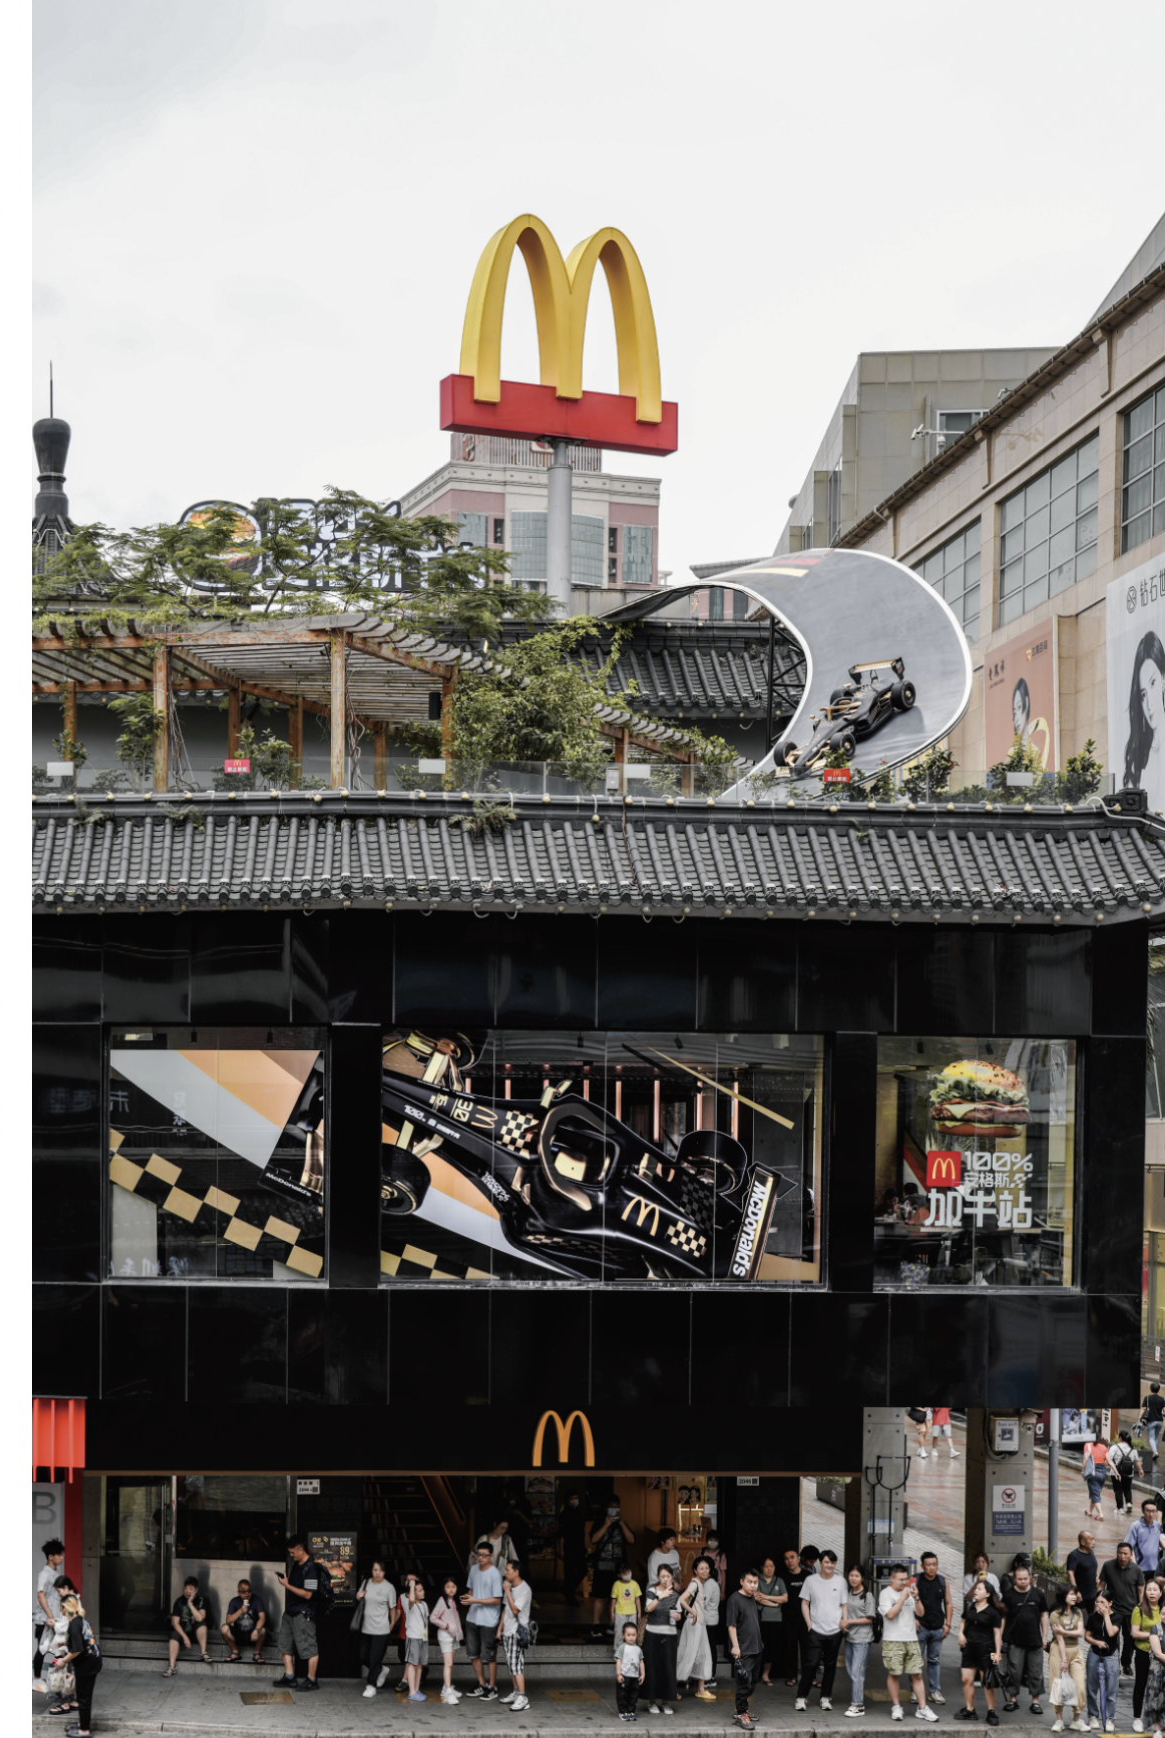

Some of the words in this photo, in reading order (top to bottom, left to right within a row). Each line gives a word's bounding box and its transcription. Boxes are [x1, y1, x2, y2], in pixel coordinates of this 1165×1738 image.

[964, 1151, 1033, 1171] 100%
[265, 1172, 312, 1197] McDonald's
[963, 1172, 1010, 1188] 安格斯
[924, 1188, 1032, 1229] 加牛站
[732, 1181, 769, 1277] McDonald's
